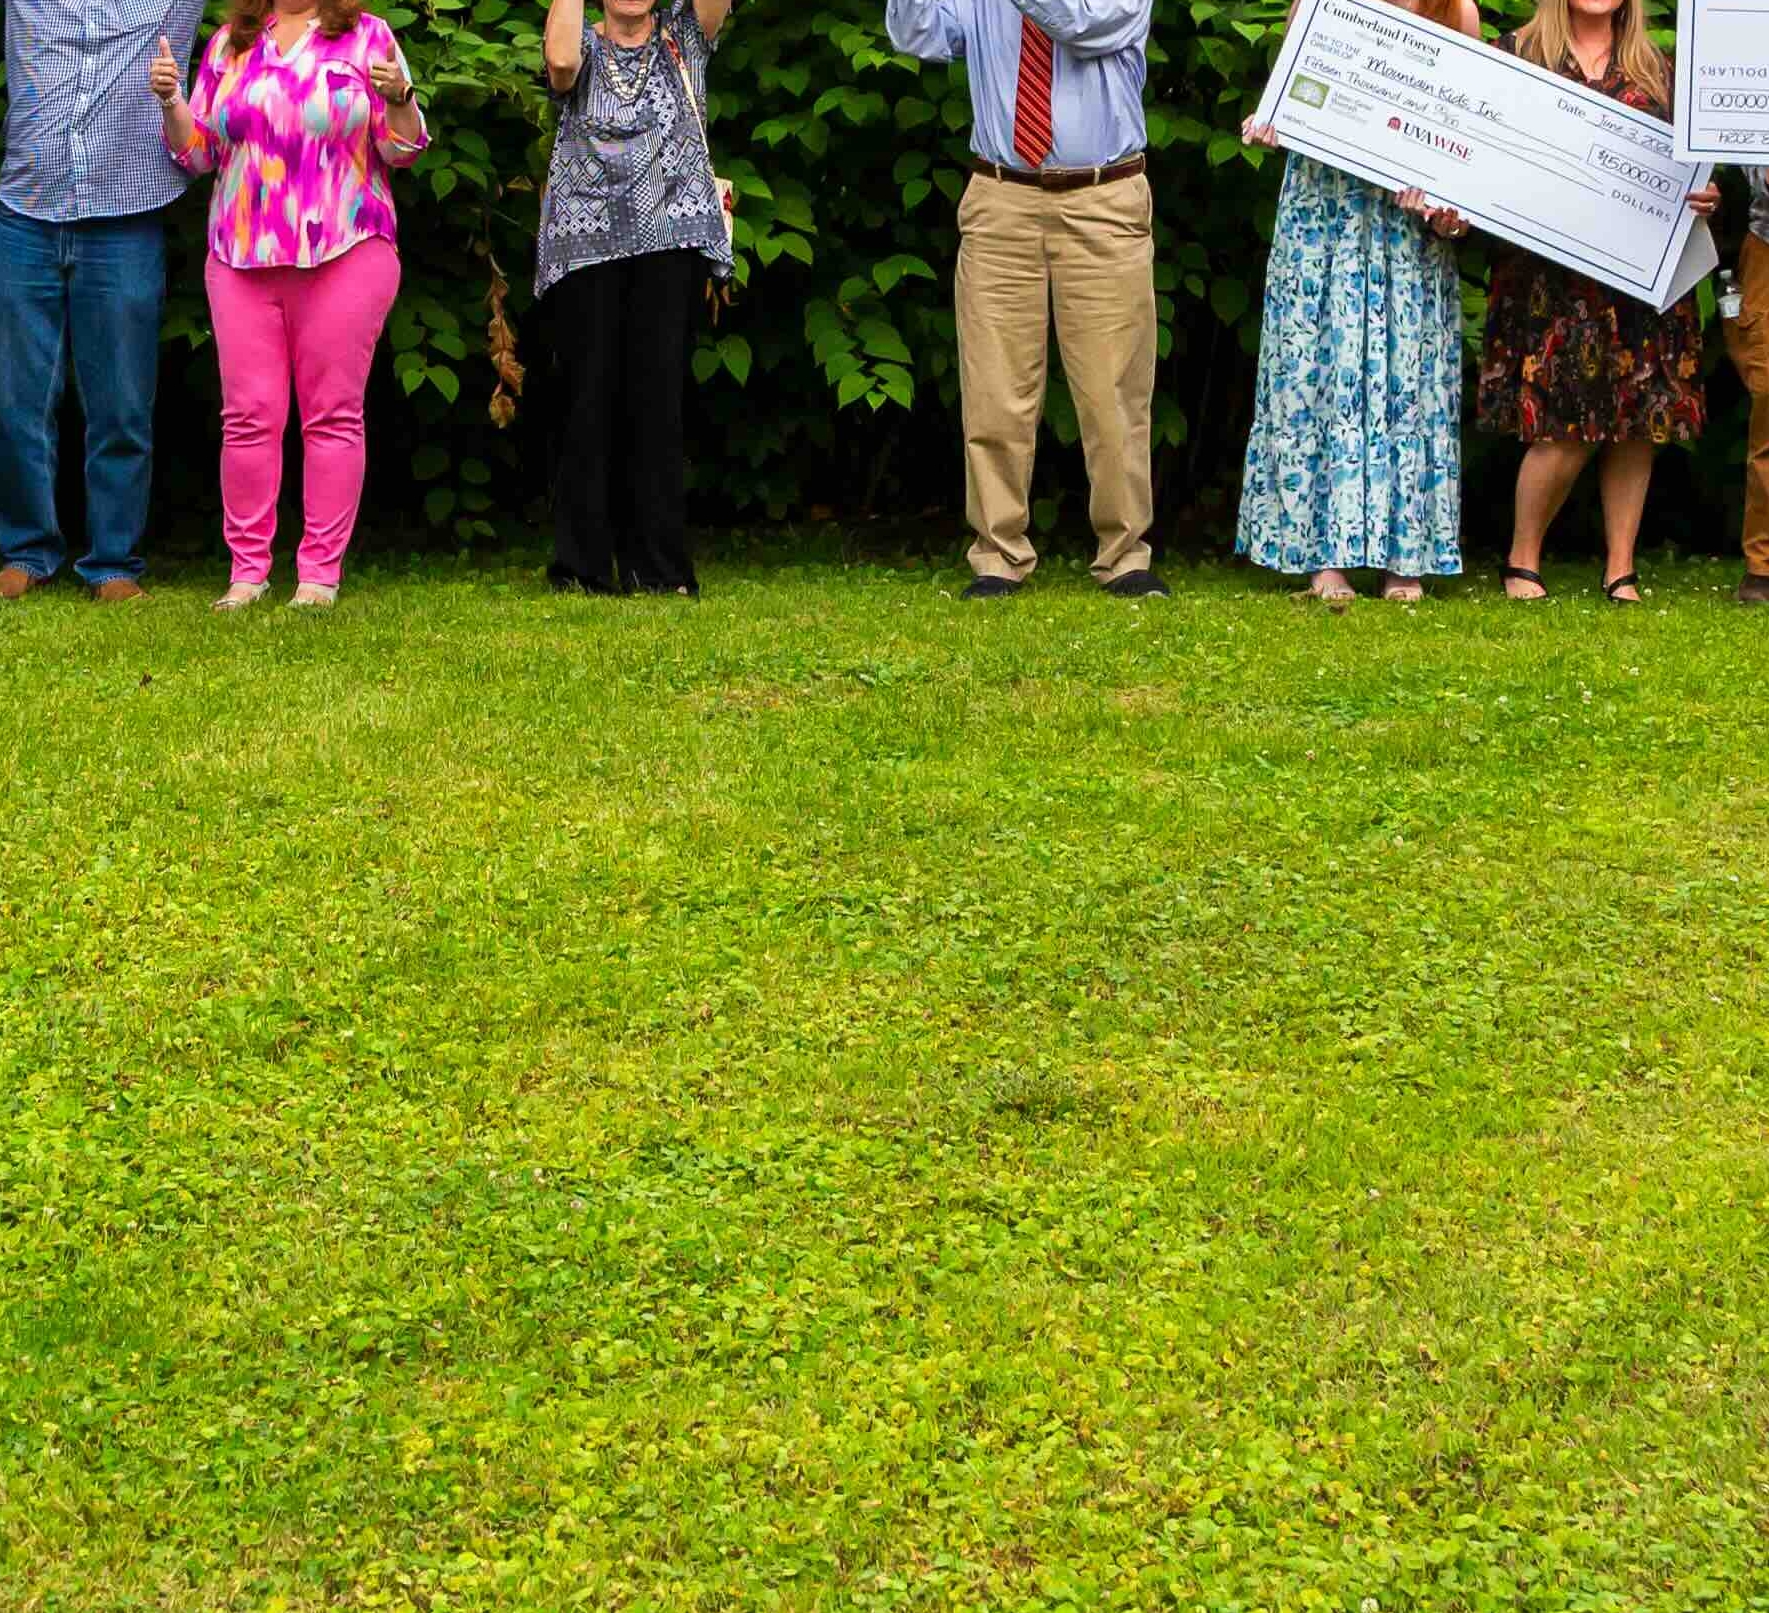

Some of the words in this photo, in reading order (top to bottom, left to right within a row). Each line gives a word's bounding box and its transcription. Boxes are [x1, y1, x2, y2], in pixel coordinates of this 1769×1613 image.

[1323, 1, 1400, 40] Cumberland
[1402, 33, 1441, 56] Forest
[1365, 56, 1434, 95] Mountain
[1699, 66, 1766, 77] DOLLARS
[1346, 71, 1401, 102] Thousand
[1402, 96, 1427, 112] and
[1556, 98, 1587, 118] Date
[1597, 114, 1624, 135] June
[1718, 131, 1755, 144] 2024
[1611, 189, 1671, 221] DOLLARS
